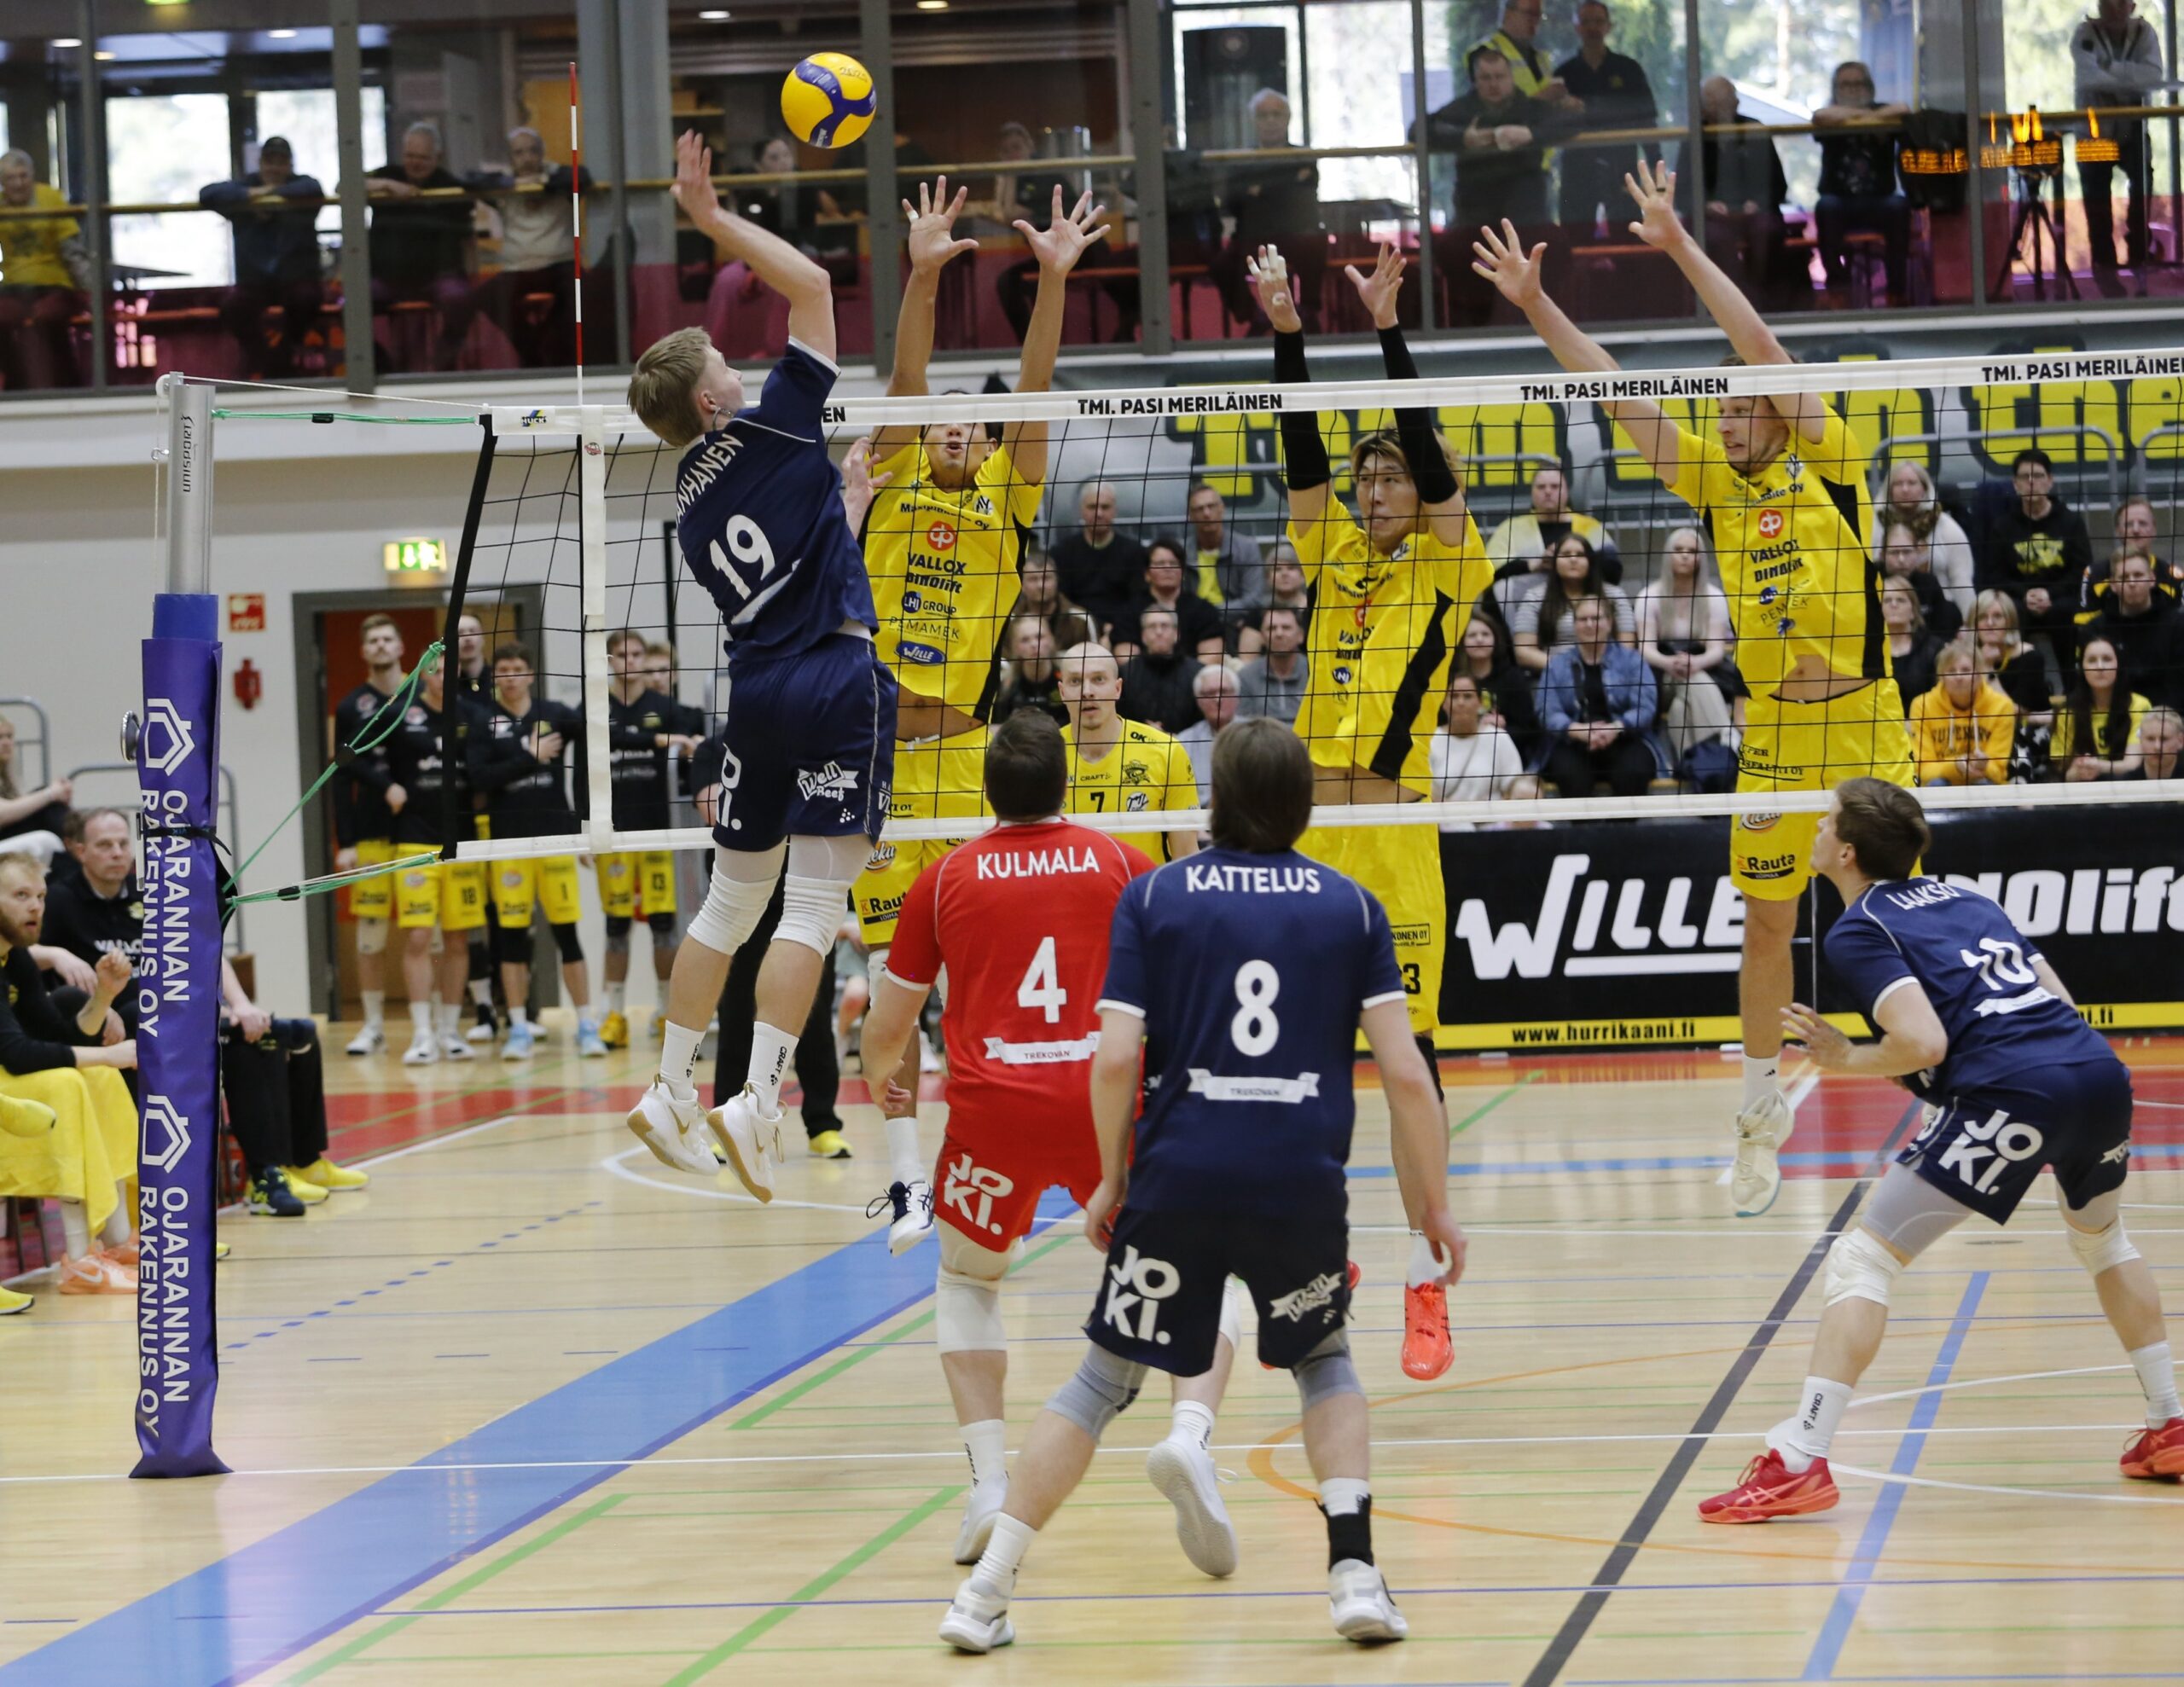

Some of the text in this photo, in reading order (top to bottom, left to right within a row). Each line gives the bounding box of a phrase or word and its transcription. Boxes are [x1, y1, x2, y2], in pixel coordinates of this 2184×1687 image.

[1982, 366, 2022, 382] TMI.
[2027, 362, 2071, 380] PASI
[1077, 391, 1283, 415] TMI. PASI MERILÄINEN
[1520, 375, 1728, 401] TMI. PASI MERILÄINEN
[183, 425, 192, 493] unisport
[709, 513, 776, 601] 19
[907, 553, 967, 575] VALLOX
[922, 600, 957, 615] GROUP
[903, 646, 935, 661] WILLE
[1130, 731, 1147, 743] OK
[800, 761, 839, 794] Well
[1080, 773, 1105, 782] CRAFT
[1090, 791, 1105, 814] 7
[869, 841, 897, 862] eku
[977, 846, 1101, 880] KULMALA
[1747, 854, 1796, 871] Rauta
[1186, 864, 1321, 894] KATTELUS
[162, 790, 191, 1001] OJARANNAN
[869, 893, 906, 913] Rau
[1885, 882, 1962, 911] LAAKSO
[138, 790, 162, 1038] RAKENNUS OY
[880, 911, 898, 921] LOIMA
[1455, 853, 1745, 980] WILLE
[1017, 936, 1067, 1023] 4
[1959, 937, 2038, 992] 10
[1230, 959, 1281, 1058] 8
[1513, 1019, 1695, 1042] www.hurrikaani.fi
[775, 1046, 787, 1074] CRAFT
[1024, 1049, 1072, 1061] TREKOVAN
[1964, 1109, 2044, 1162] JO
[948, 1153, 1014, 1197] JO
[1937, 1132, 2000, 1195] KI.
[944, 1173, 1003, 1236] KI.
[1108, 1244, 1181, 1300] JO
[162, 1186, 190, 1402] OJARANNAN
[138, 1186, 160, 1438] RAKENNUS OY
[1103, 1278, 1171, 1345] KI.
[1808, 1393, 1824, 1421] CRAFT
